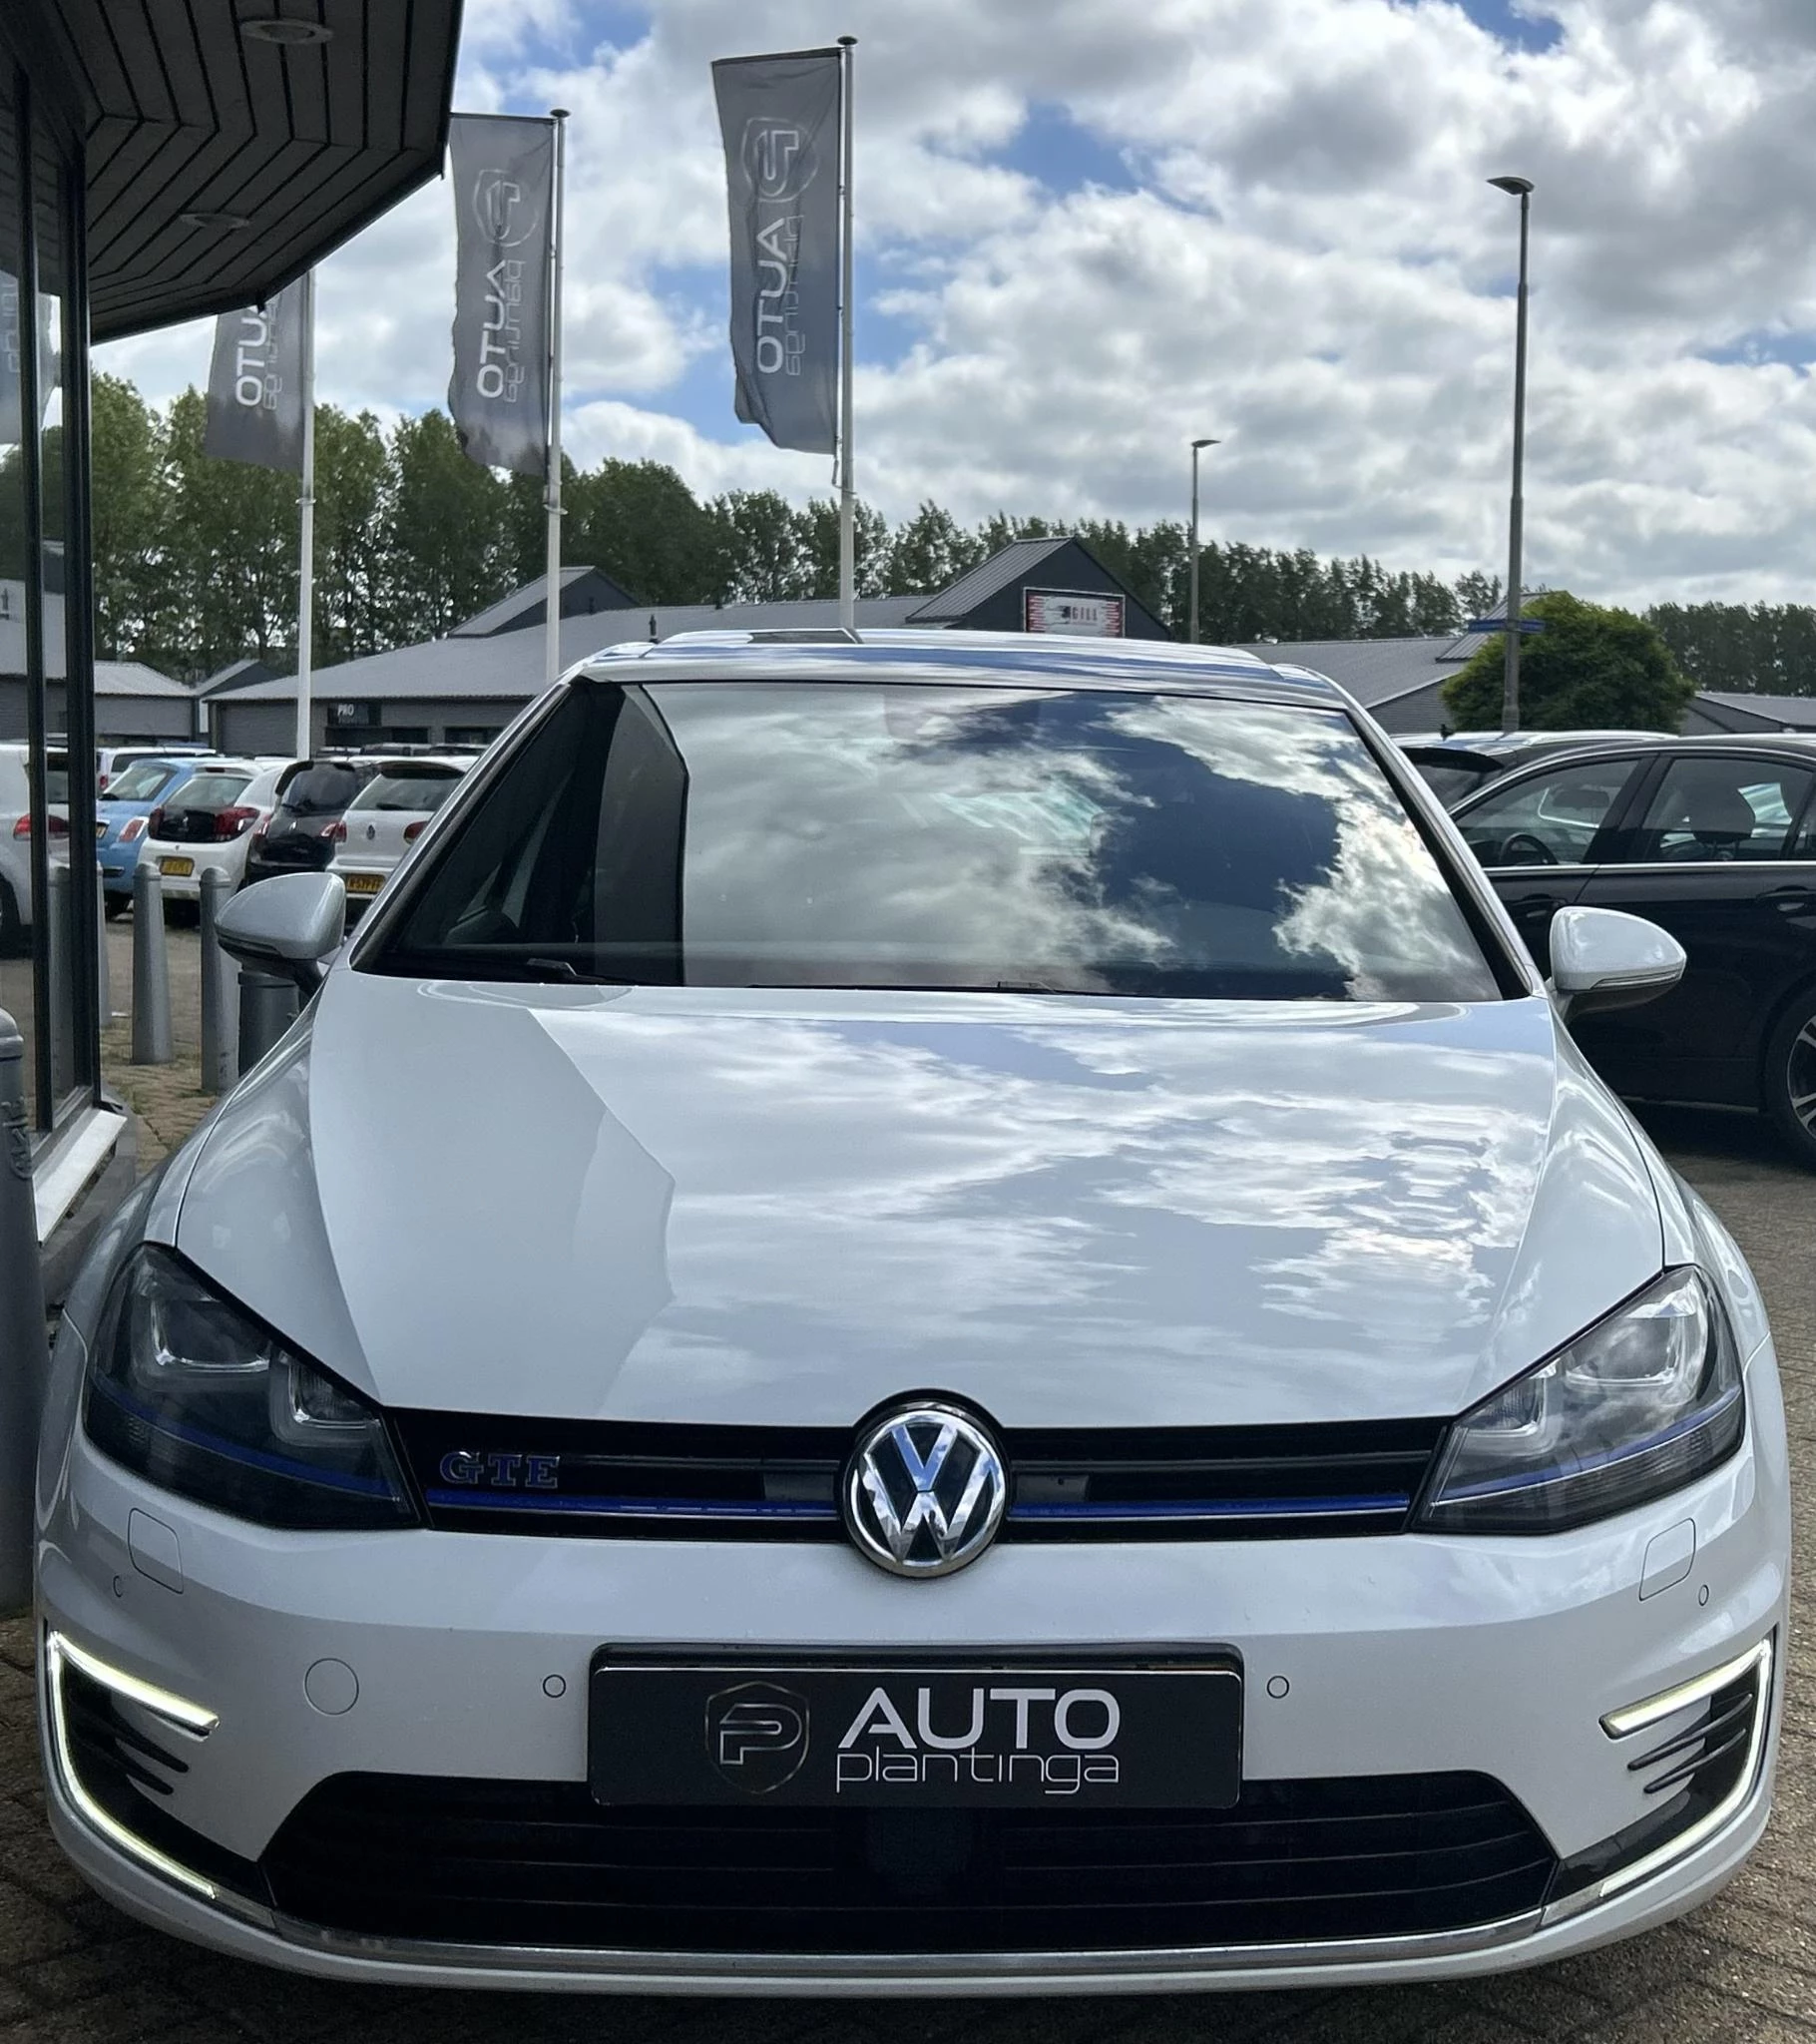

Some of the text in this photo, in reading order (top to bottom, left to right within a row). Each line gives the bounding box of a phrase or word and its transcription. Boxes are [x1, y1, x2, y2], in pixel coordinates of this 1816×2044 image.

[439, 1451, 561, 1489] GTE
[838, 1687, 1121, 1750] AUTO
[836, 1746, 1120, 1794] plantinga
